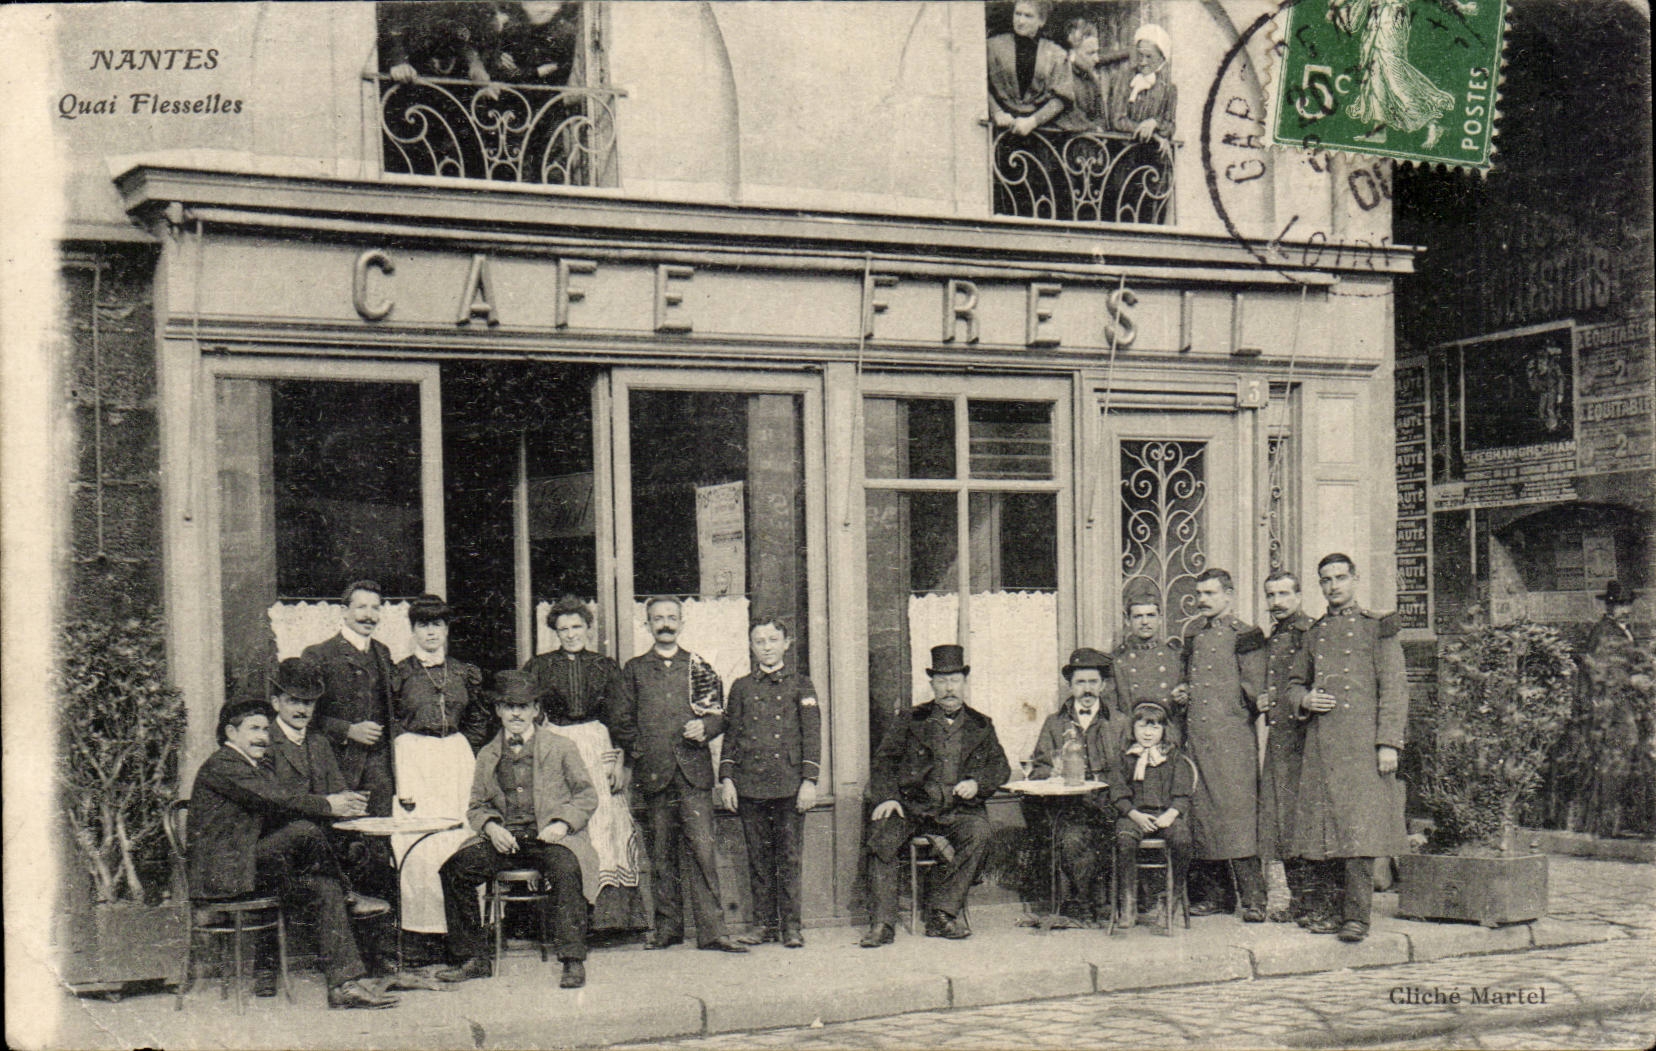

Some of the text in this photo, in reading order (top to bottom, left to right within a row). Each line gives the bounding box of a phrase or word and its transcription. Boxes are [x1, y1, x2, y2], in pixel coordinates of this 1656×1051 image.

[1462, 66, 1490, 151] POSTES
[352, 248, 1263, 357] CAFE FRESIL
